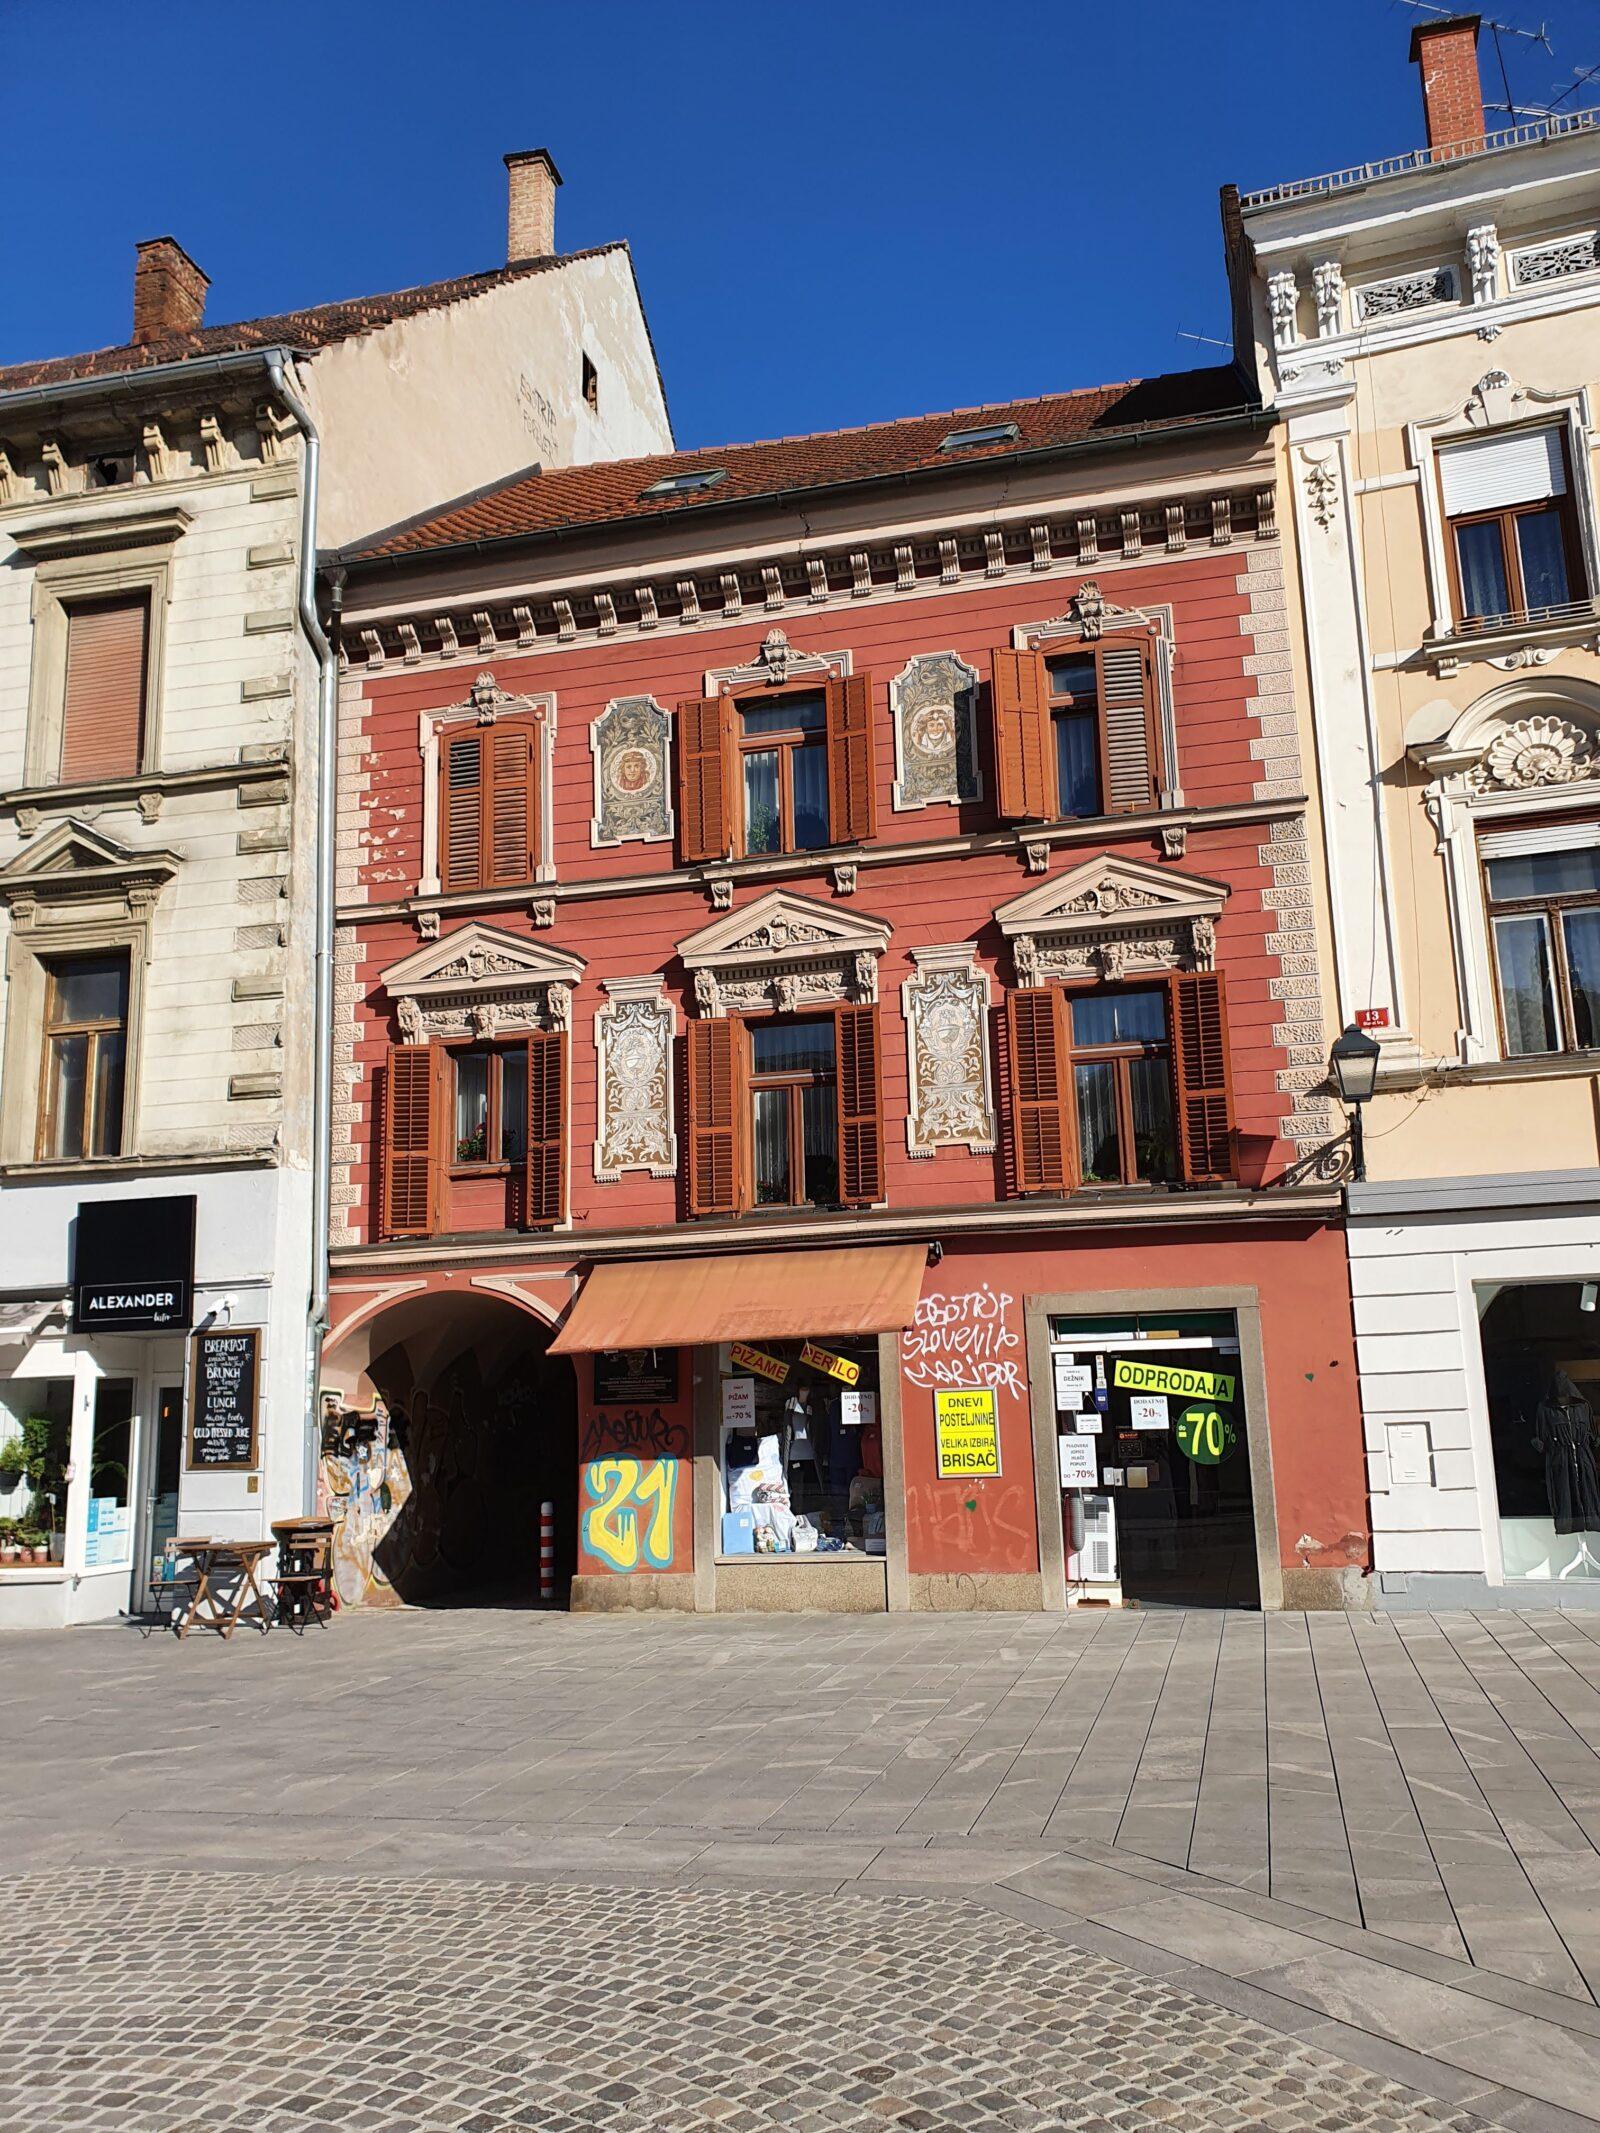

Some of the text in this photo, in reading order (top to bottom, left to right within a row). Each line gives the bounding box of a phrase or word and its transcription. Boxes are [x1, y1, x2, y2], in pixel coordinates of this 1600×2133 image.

[1365, 1010, 1379, 1021] 13
[89, 1293, 174, 1310] ALEXANDER
[204, 1338, 249, 1353] BREAKFAST
[730, 1345, 788, 1380] PIŽAME
[801, 1347, 859, 1381] PERILO
[206, 1366, 241, 1379] BRUNCH
[1119, 1365, 1229, 1398] ODPRODAJA
[207, 1396, 237, 1408] LUNCH
[948, 1397, 983, 1408] DNEVI
[939, 1412, 994, 1427] POSTELJNINE
[193, 1427, 211, 1439] COLD
[234, 1426, 250, 1438] JUICE
[940, 1437, 996, 1448] VELIKA IZBIRA
[942, 1449, 996, 1467] BRISAČ
[1072, 1469, 1095, 1478] -70%
[581, 1451, 679, 1573] 21
